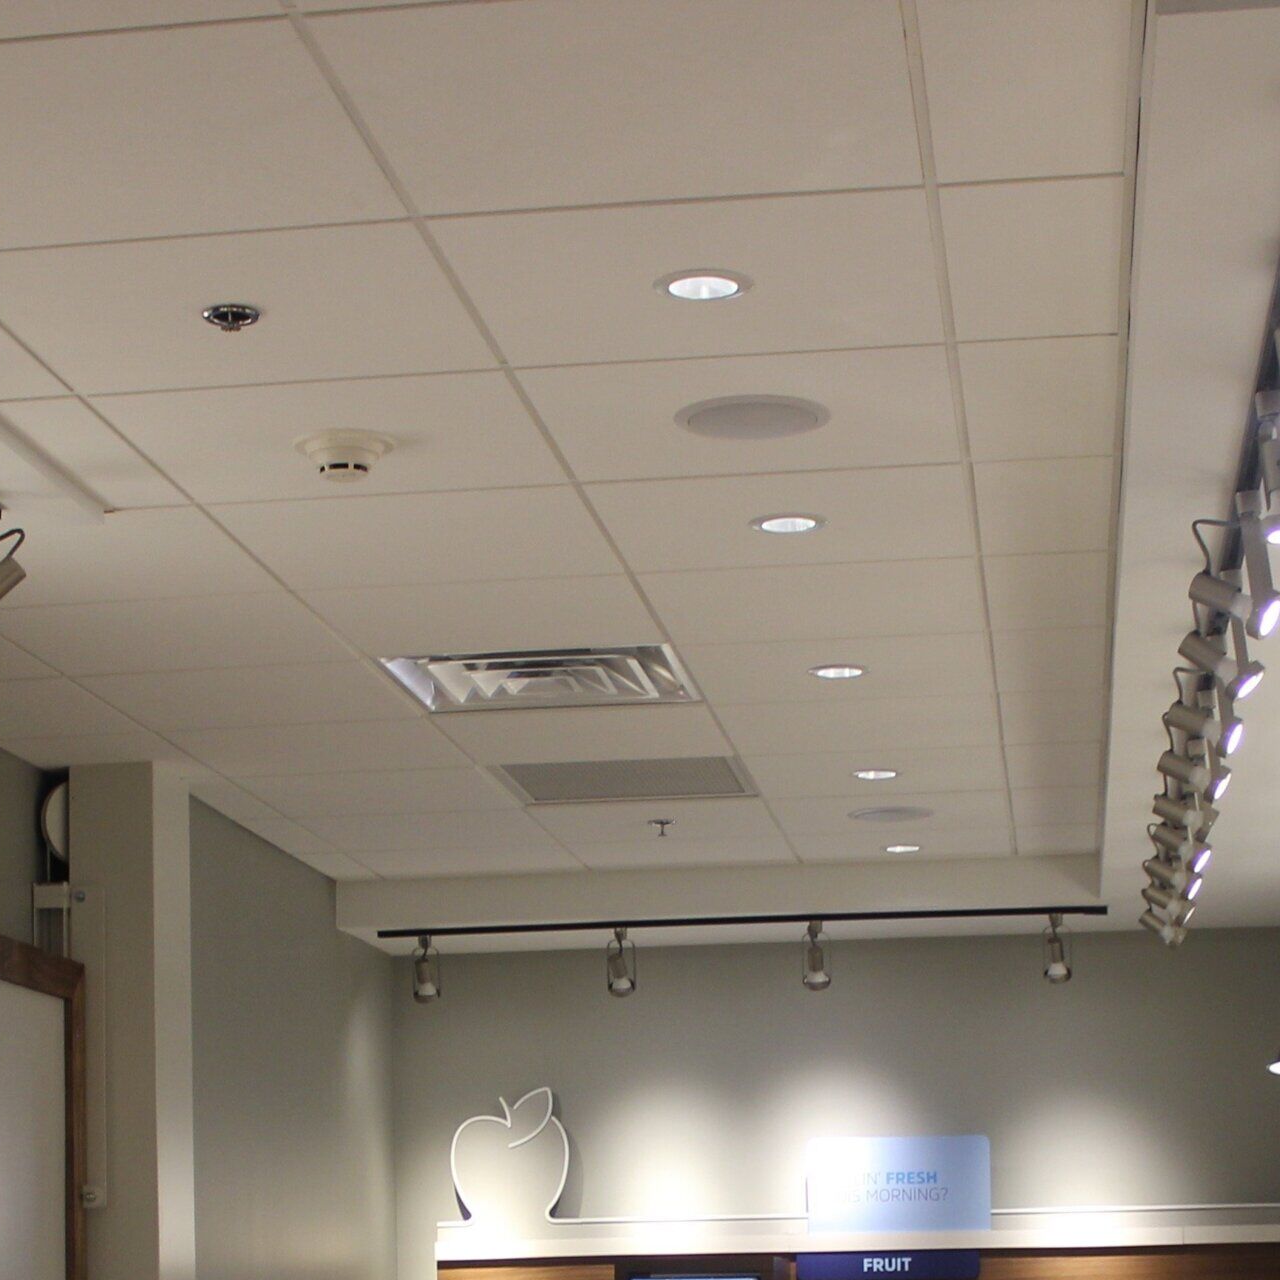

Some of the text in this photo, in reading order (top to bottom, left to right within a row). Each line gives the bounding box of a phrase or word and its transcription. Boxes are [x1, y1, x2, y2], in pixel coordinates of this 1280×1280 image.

[886, 1171, 938, 1185] FRESH
[866, 1187, 949, 1202] MORNING?
[863, 1257, 912, 1273] FRUIT
